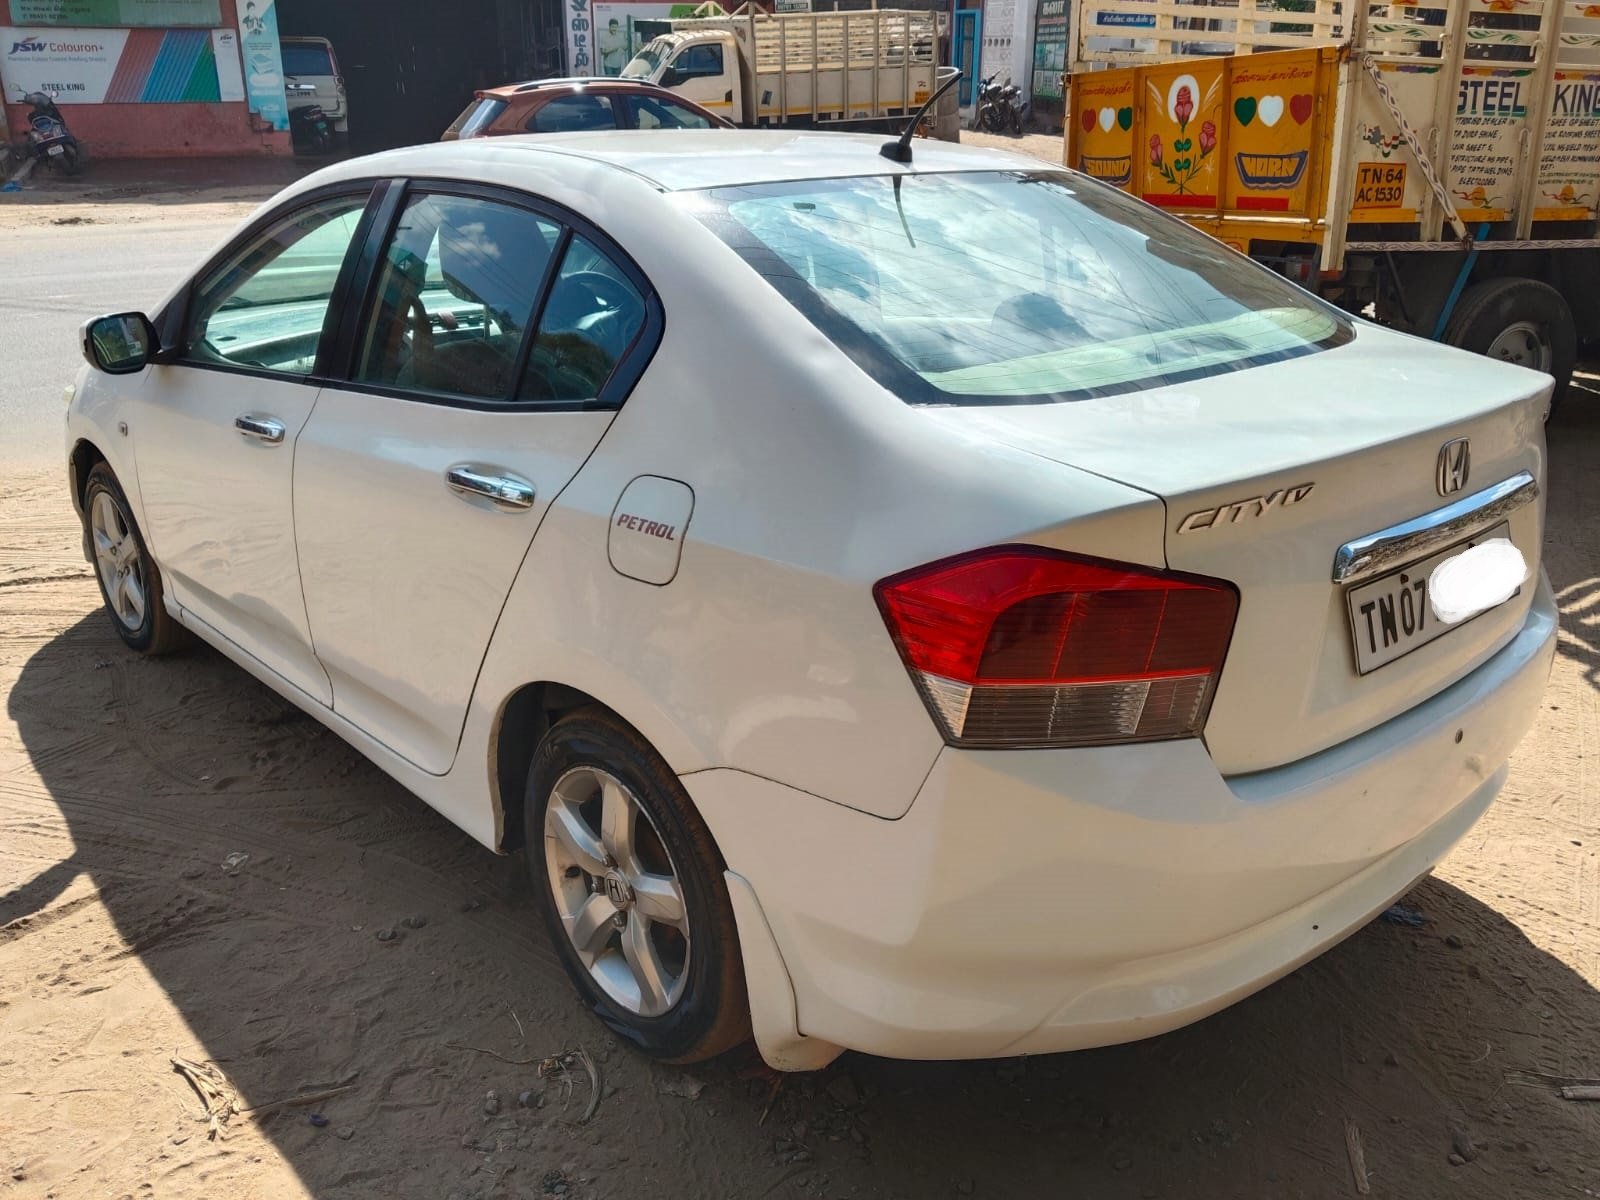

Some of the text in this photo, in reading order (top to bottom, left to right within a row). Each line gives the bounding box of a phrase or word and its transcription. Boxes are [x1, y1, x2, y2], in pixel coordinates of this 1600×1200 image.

[8, 38, 47, 55] JSW
[41, 83, 85, 91] STEEL KING
[617, 513, 676, 541] PETROL
